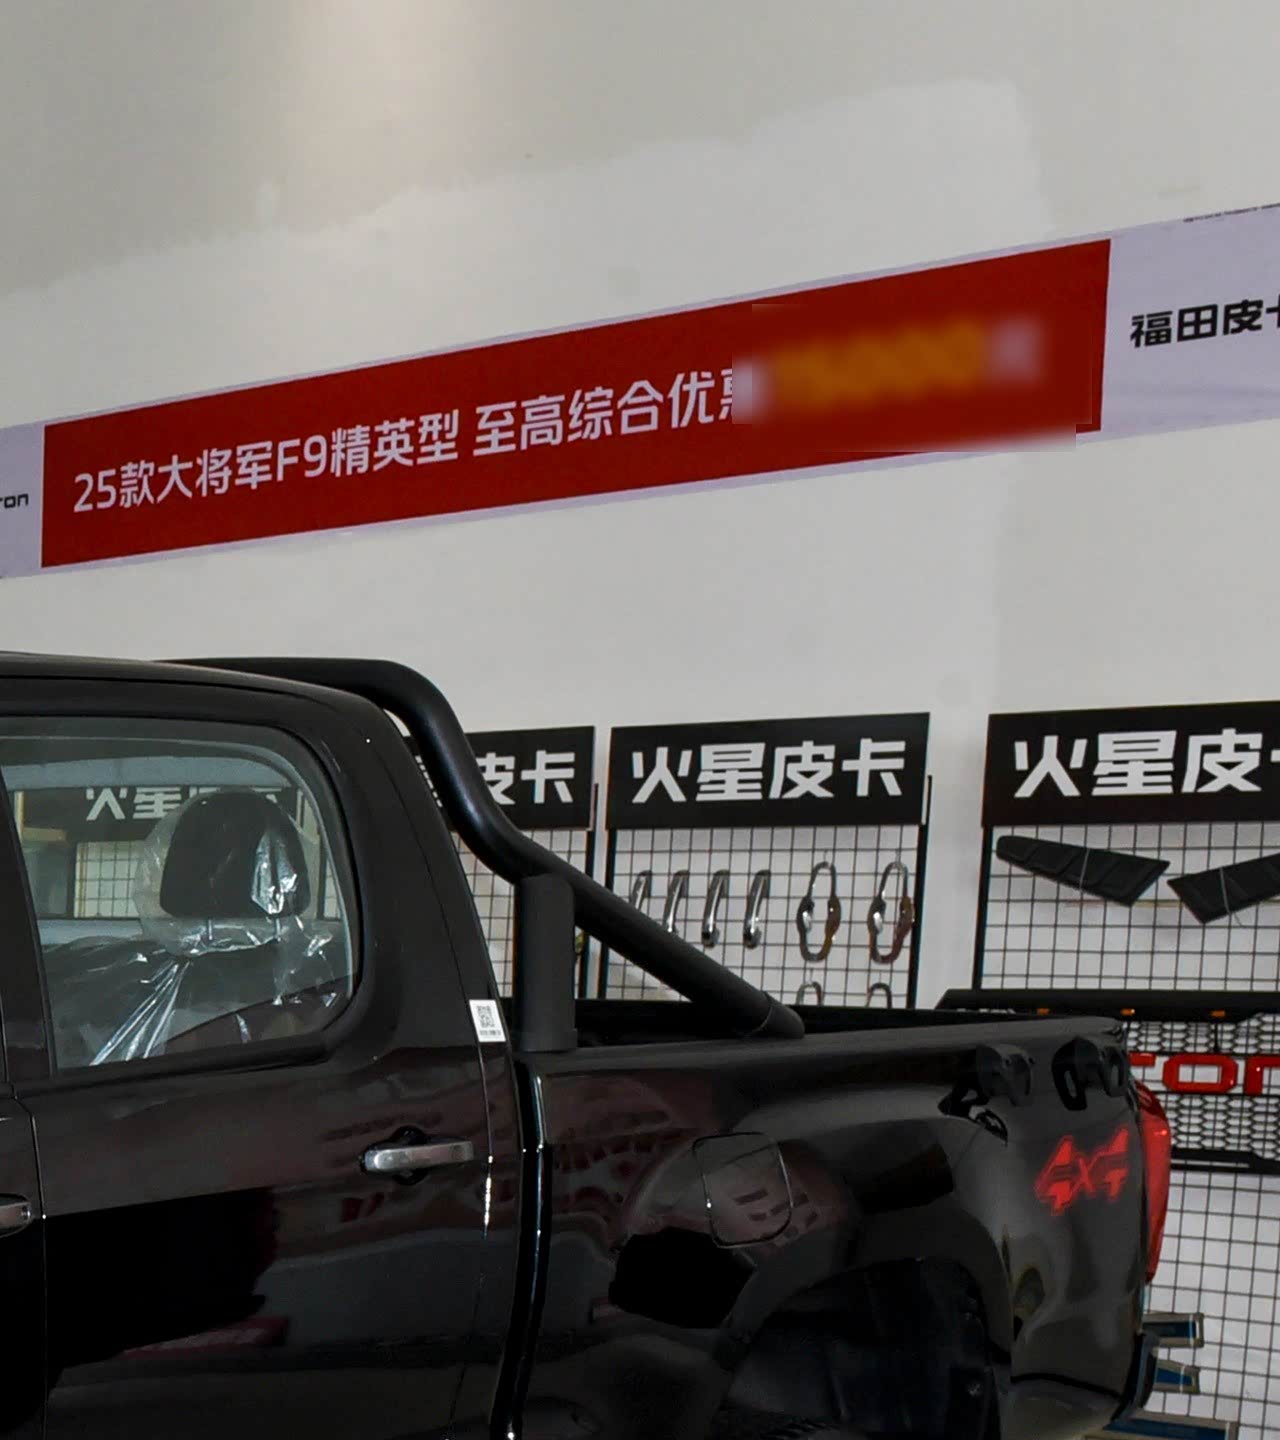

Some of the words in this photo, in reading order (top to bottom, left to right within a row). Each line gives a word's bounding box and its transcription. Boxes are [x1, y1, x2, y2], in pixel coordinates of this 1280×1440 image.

[73, 410, 460, 513] 25款大将军F9精英型
[416, 750, 575, 806] 皮卡
[631, 737, 903, 804] 火星皮卡
[1014, 727, 1280, 798] 火星皮
